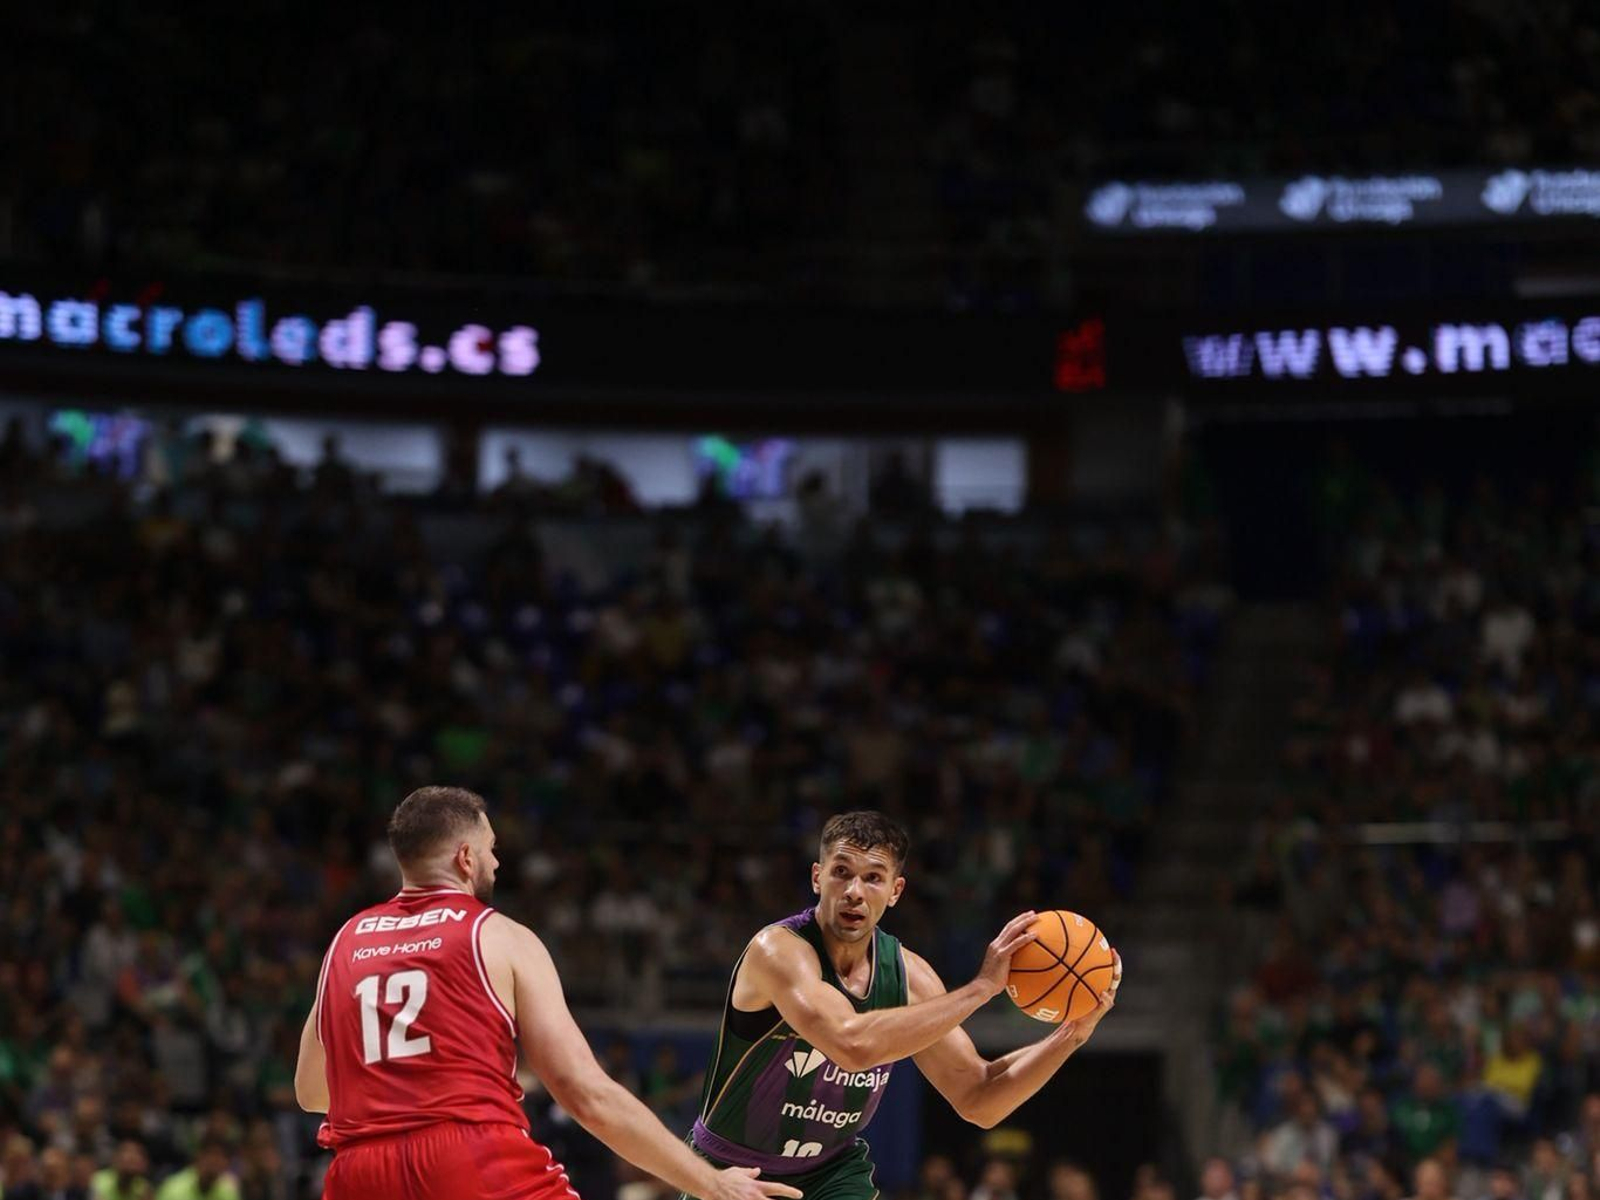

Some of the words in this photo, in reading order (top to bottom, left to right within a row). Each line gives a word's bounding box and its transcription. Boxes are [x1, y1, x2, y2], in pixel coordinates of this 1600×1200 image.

[354, 907, 467, 935] GEBEN
[352, 946, 390, 963] Kave
[392, 936, 442, 954] Home
[354, 968, 431, 1066] 12
[822, 1064, 890, 1092] Unicaja
[781, 1099, 863, 1129] málaga
